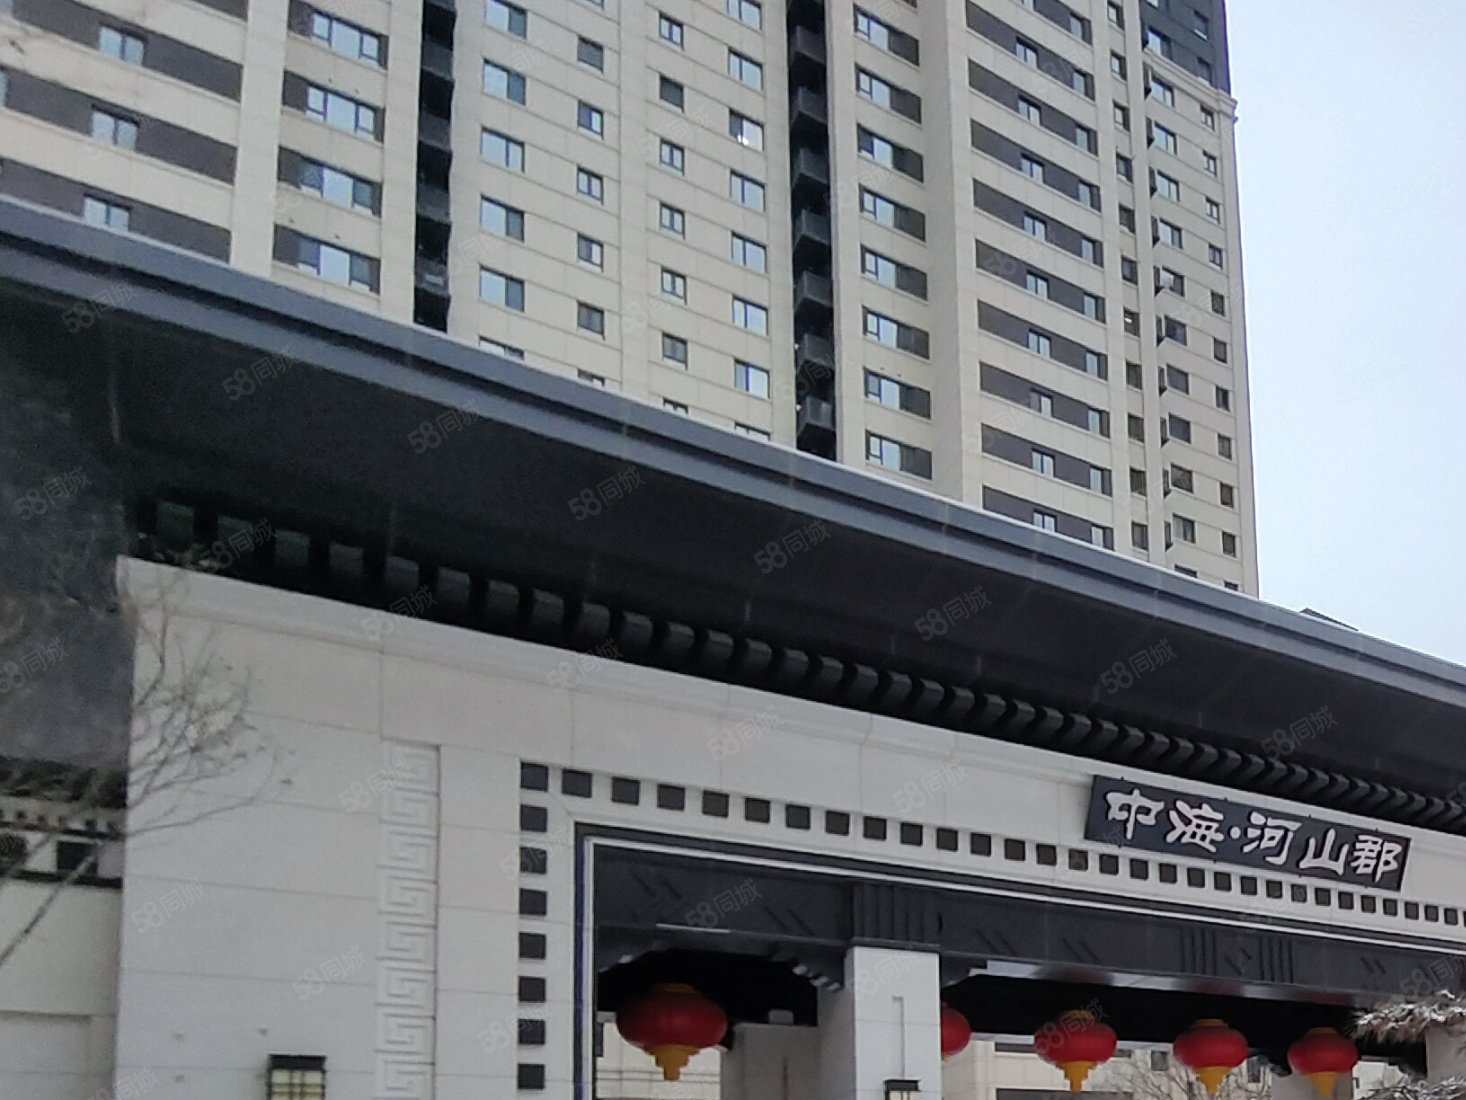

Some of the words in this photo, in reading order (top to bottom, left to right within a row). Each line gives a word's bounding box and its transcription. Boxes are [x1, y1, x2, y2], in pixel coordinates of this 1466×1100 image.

[1104, 787, 1404, 884] 中海·河山郡
